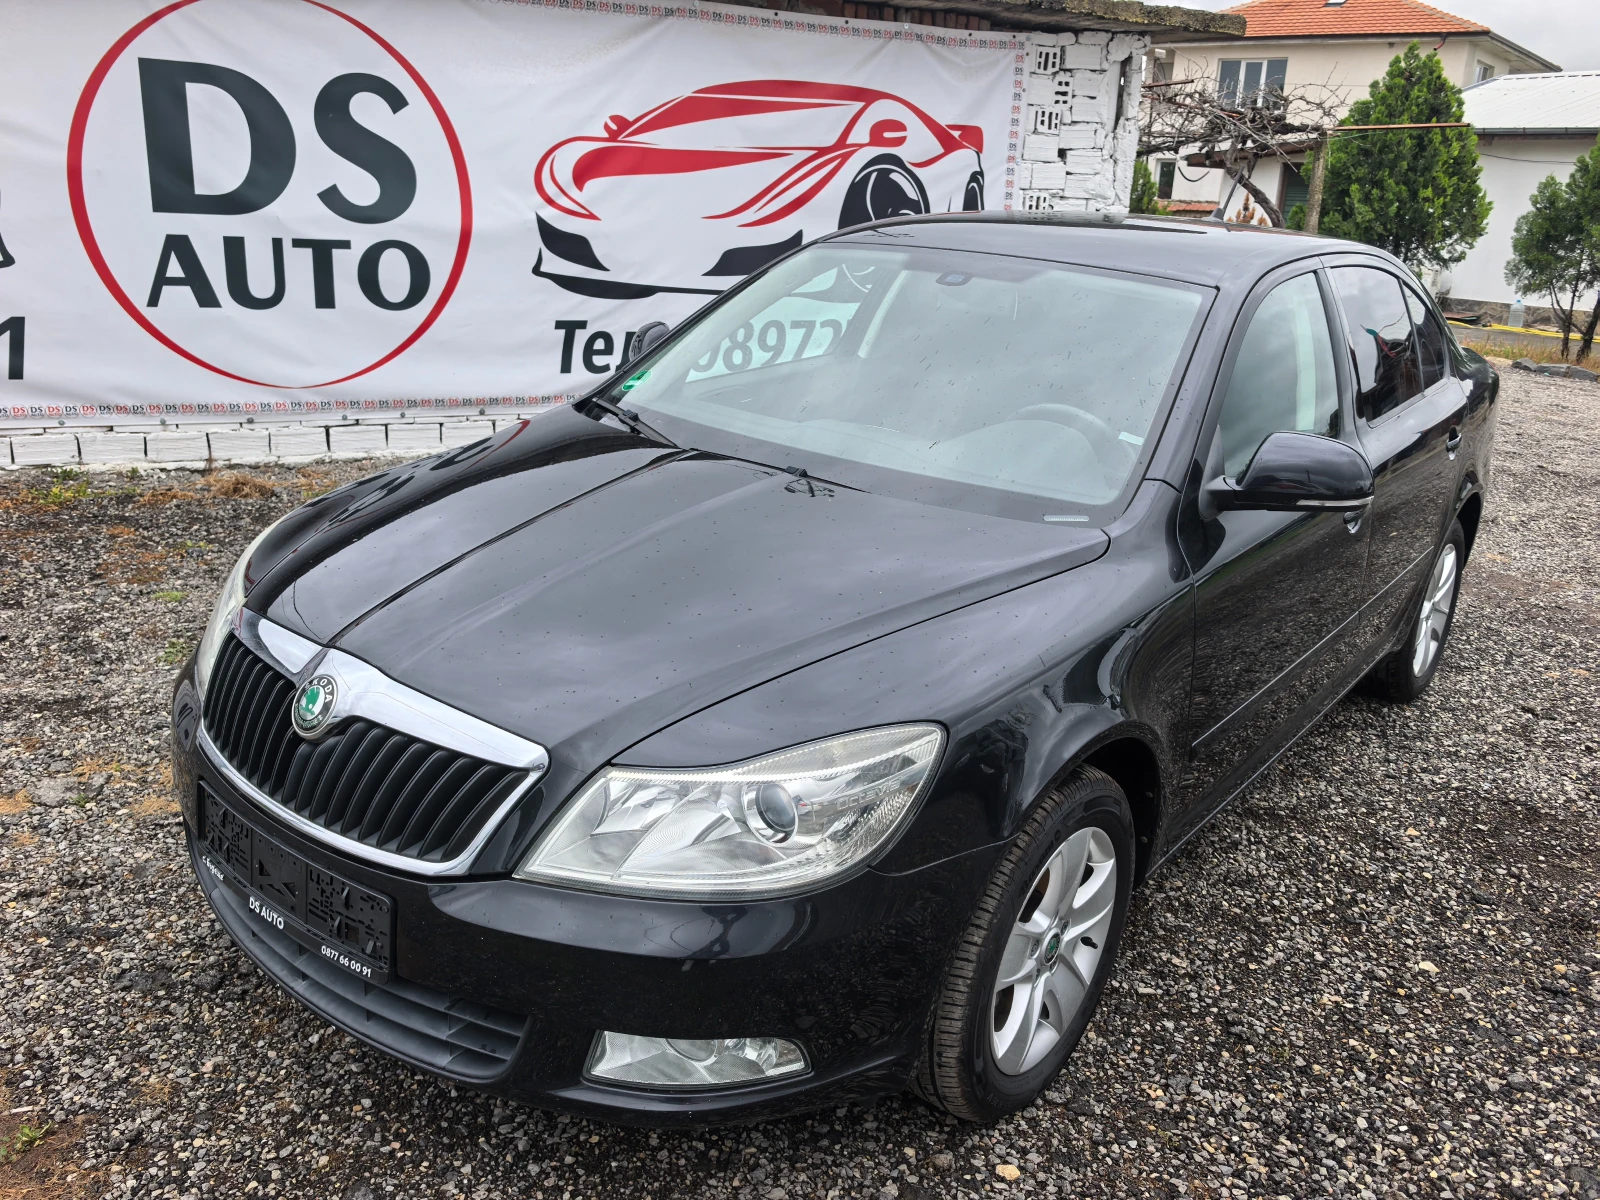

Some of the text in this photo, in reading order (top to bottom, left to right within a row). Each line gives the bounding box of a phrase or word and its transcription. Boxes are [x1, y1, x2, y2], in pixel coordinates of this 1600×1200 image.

[138, 57, 418, 224] DS
[147, 234, 430, 310] AUTO
[249, 896, 284, 929] DS AUTO
[321, 945, 371, 977] 0877 66 00 91
